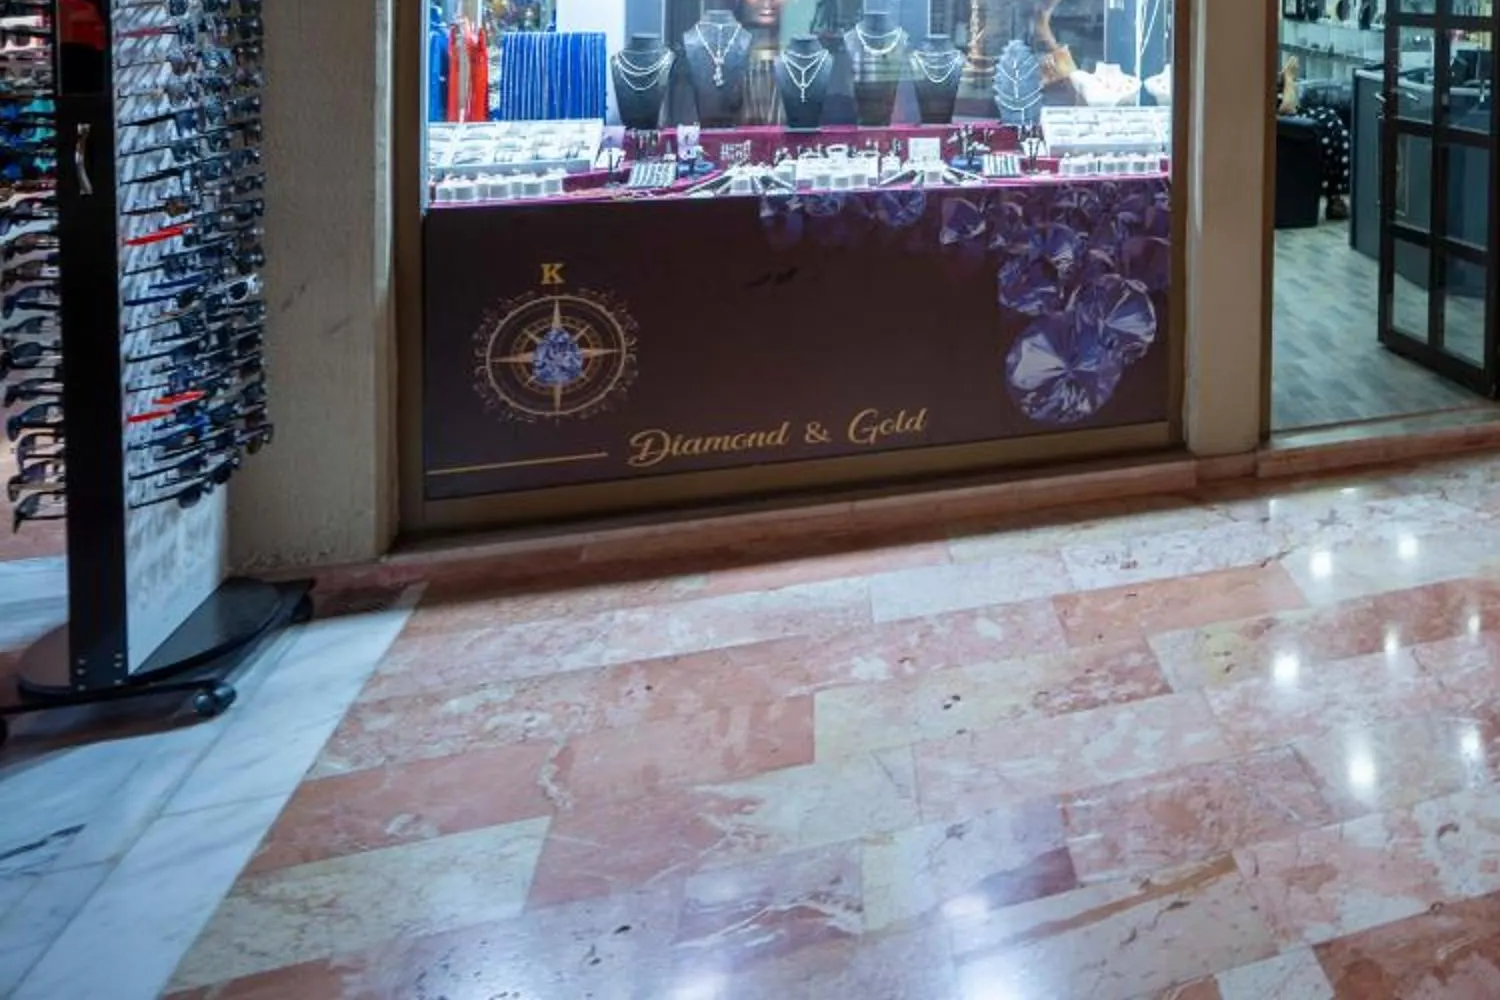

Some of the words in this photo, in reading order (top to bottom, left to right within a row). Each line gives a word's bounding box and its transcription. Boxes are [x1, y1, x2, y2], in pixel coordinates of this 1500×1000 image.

[540, 262, 566, 286] K
[627, 421, 791, 468] Diamond
[803, 420, 833, 445] &
[847, 406, 928, 446] Gold
